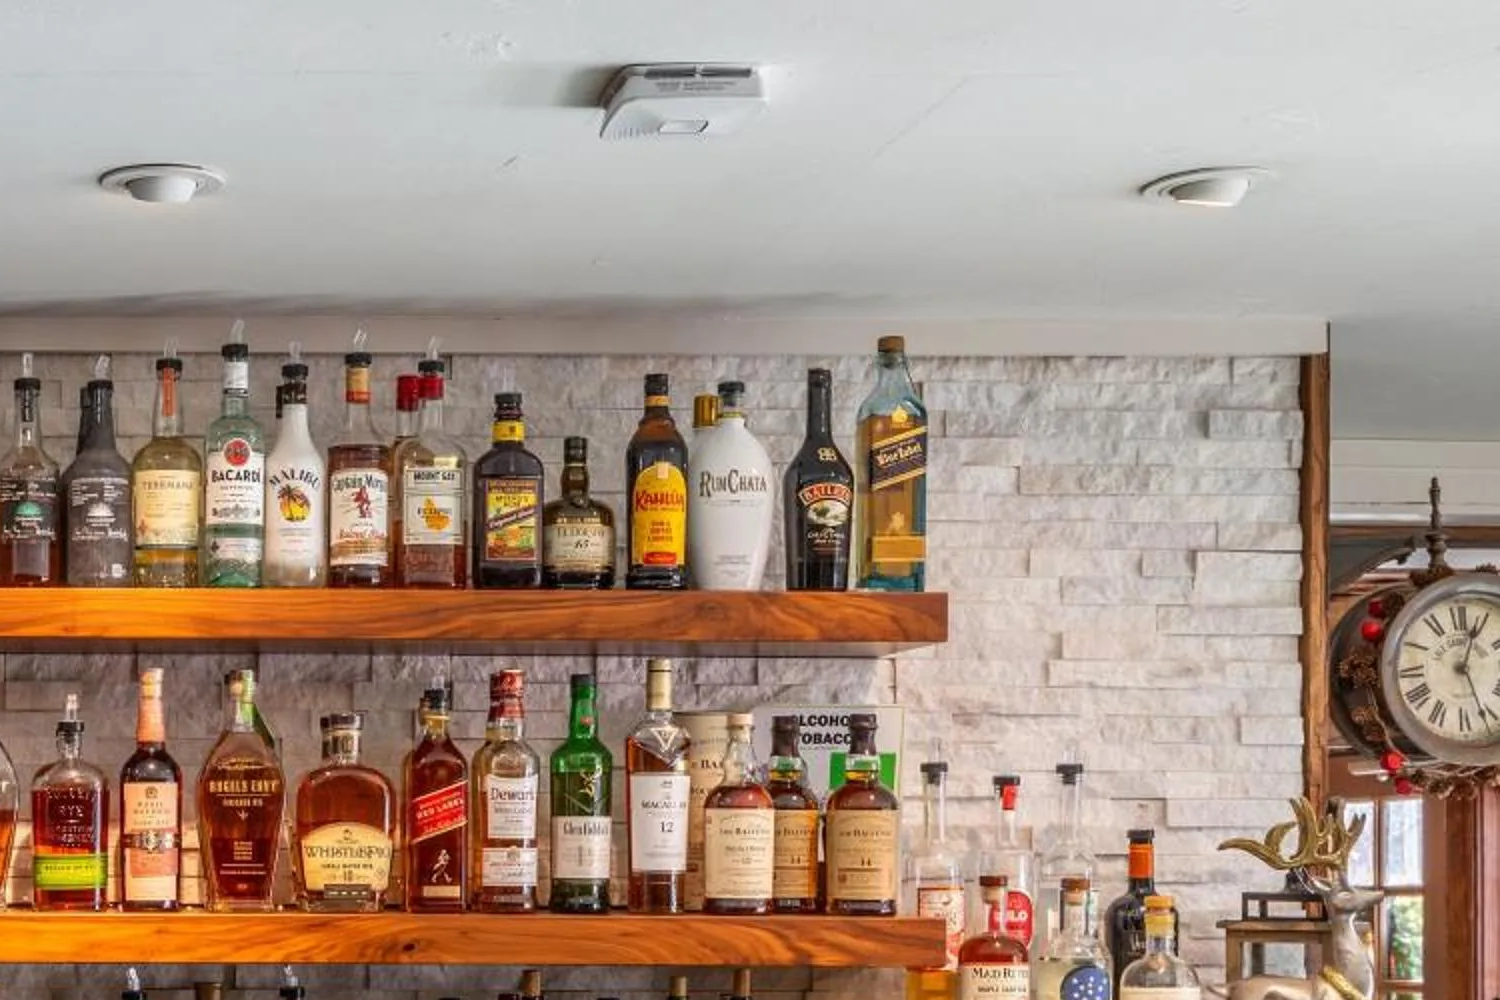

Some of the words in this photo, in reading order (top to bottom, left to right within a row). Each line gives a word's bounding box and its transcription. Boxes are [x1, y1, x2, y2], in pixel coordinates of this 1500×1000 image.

[796, 714, 851, 728] LCOHO
[798, 733, 851, 746] OBACC
[660, 821, 676, 833] 12
